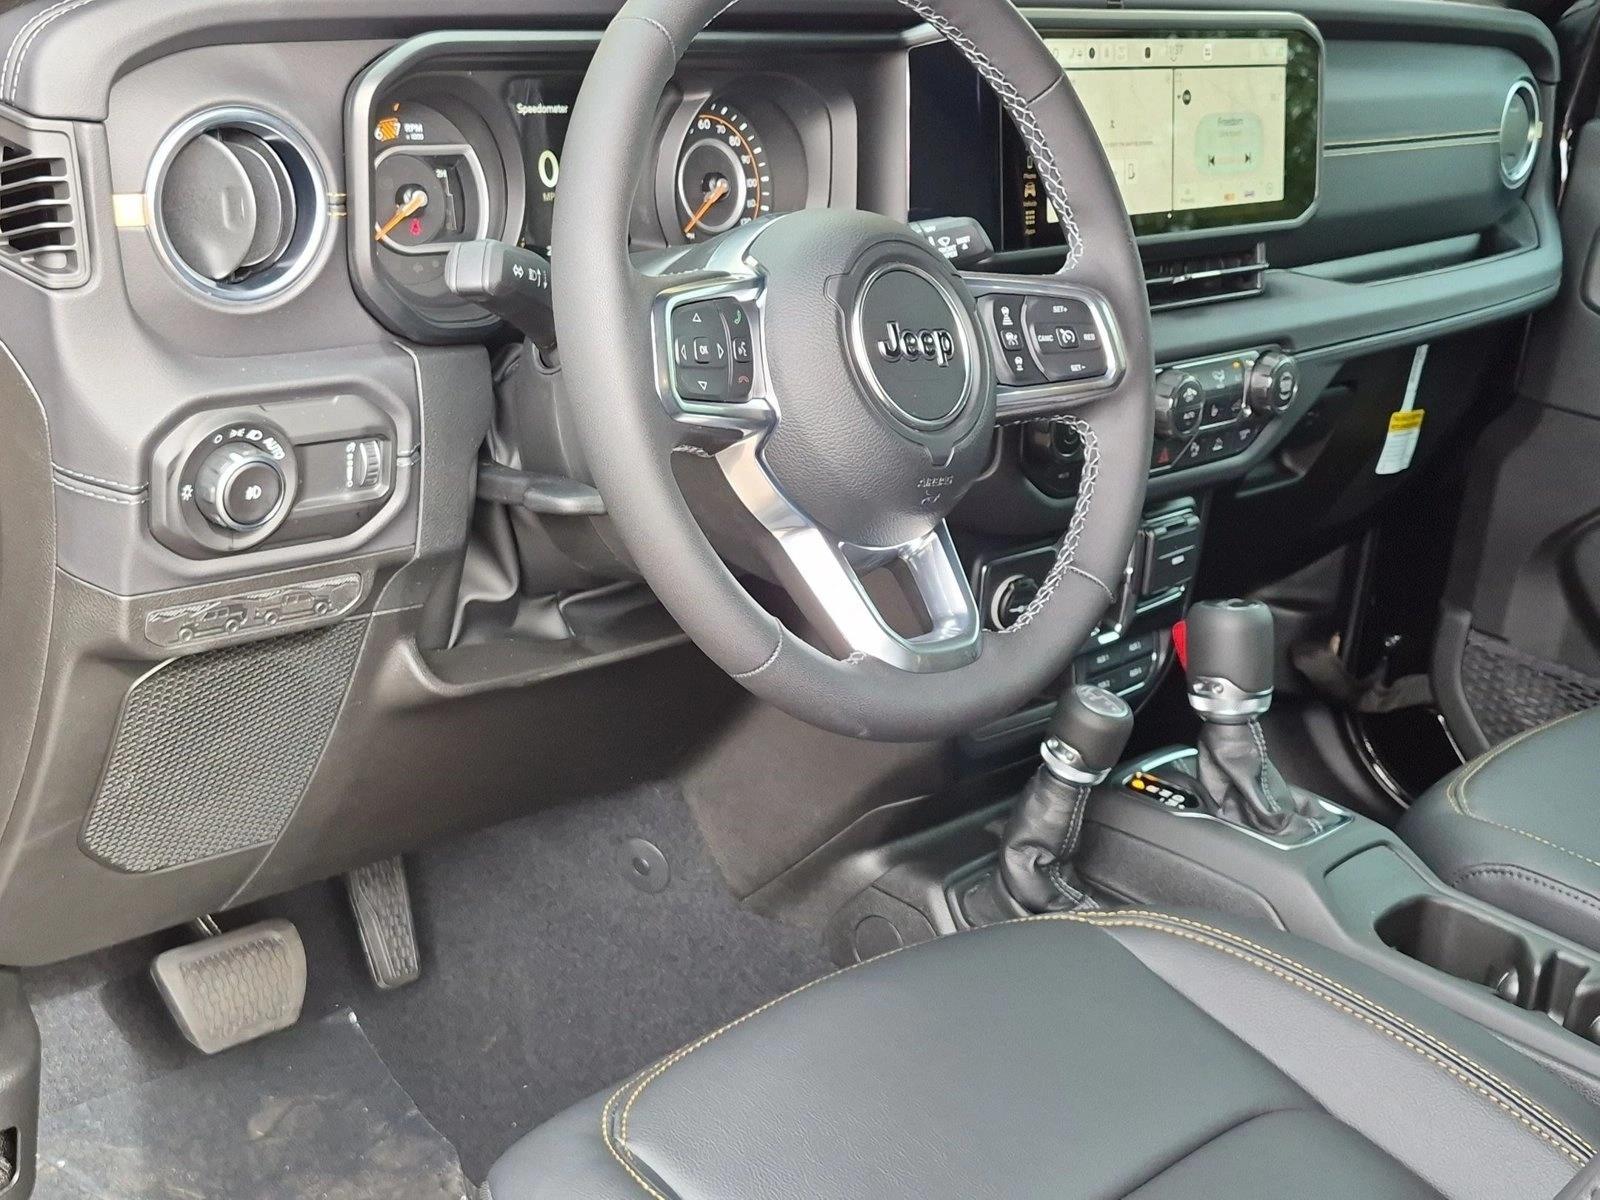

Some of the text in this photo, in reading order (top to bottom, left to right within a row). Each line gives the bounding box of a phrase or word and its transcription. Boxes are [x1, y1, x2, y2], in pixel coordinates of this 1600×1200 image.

[516, 102, 569, 116] Speedometer
[404, 123, 424, 133] RPM
[698, 119, 711, 130] 60
[538, 150, 560, 188] 0
[1052, 305, 1068, 313] SET+
[699, 345, 709, 355] OK
[877, 321, 955, 368] Jeep
[262, 437, 285, 460] AUTO
